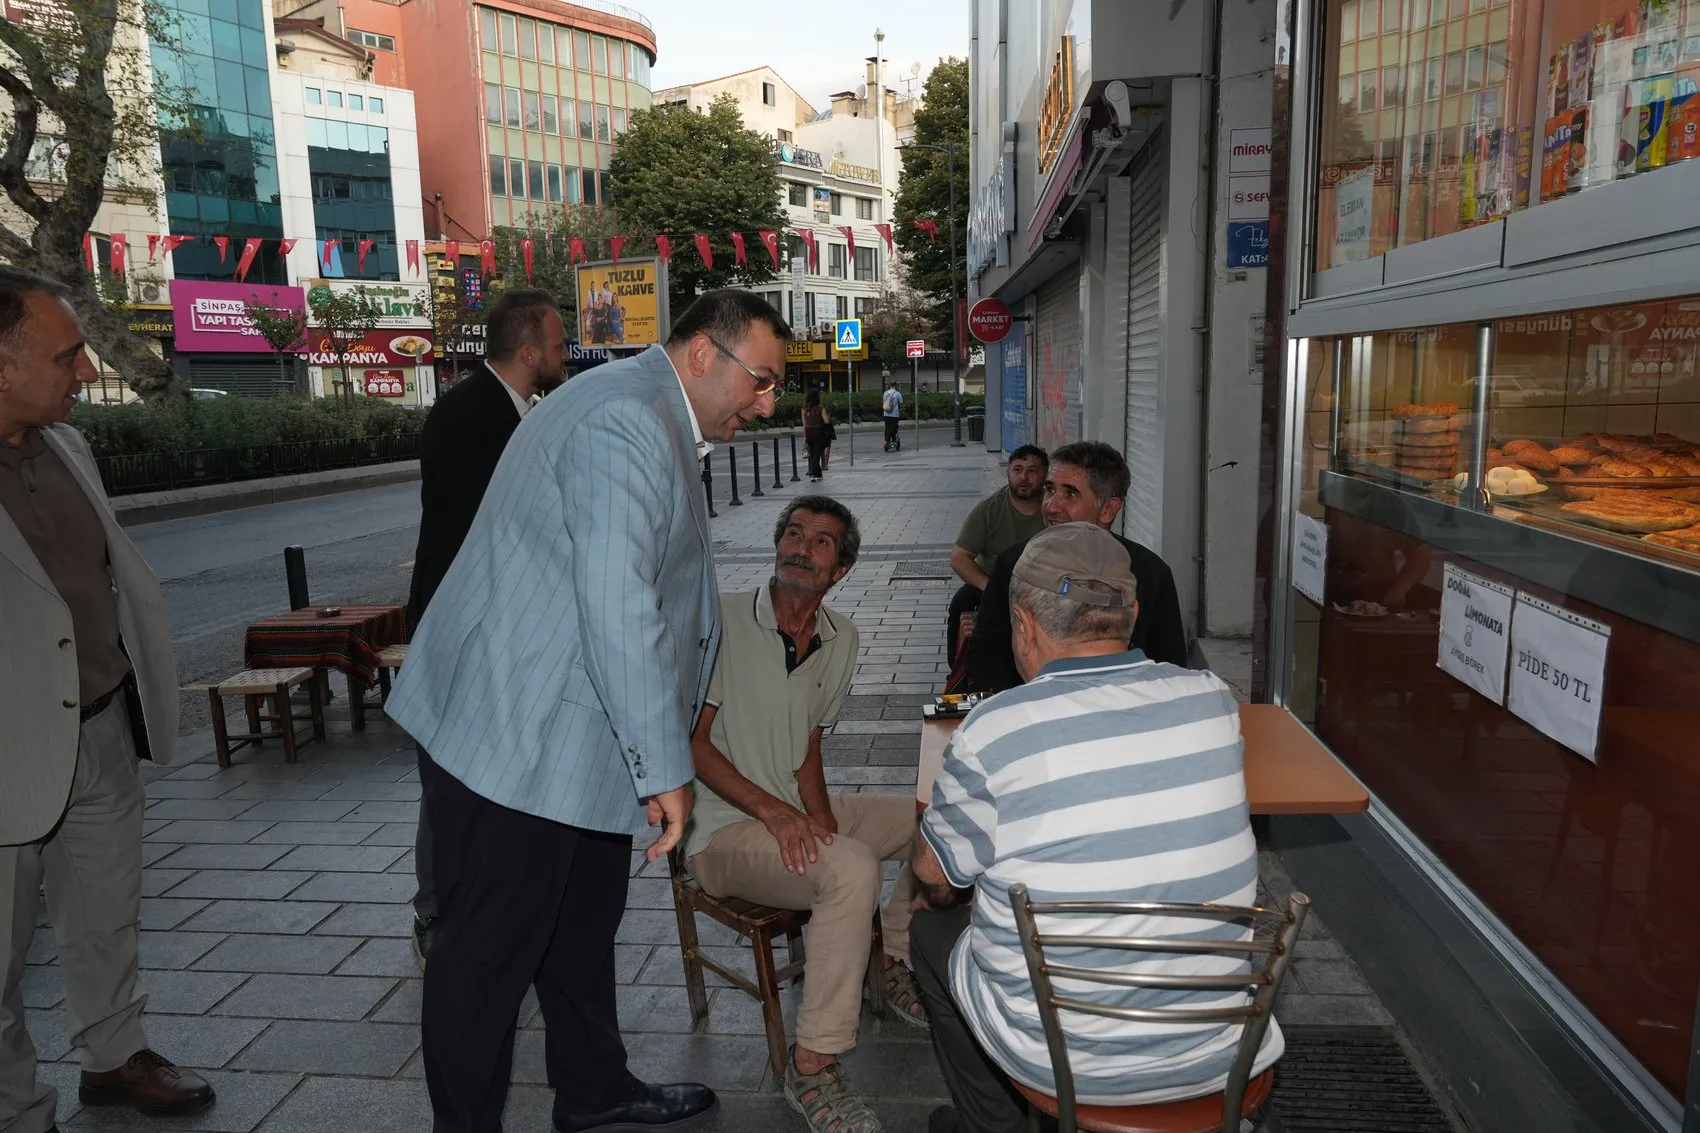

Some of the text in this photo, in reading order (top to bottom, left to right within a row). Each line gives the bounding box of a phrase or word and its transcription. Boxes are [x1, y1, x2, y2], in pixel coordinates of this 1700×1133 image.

[608, 269, 645, 283] TUZLU
[617, 283, 654, 296] KAHVE
[201, 301, 241, 312] SİNPAŞ
[198, 315, 227, 326] YAPI
[972, 315, 1009, 324] MARKET
[787, 342, 811, 355] EYFEL
[1447, 577, 1471, 599] DOĞAL
[1464, 604, 1503, 636] LİMONATA
[1465, 654, 1485, 675] BÖREK
[1517, 650, 1592, 704] PİDE 50 TL
